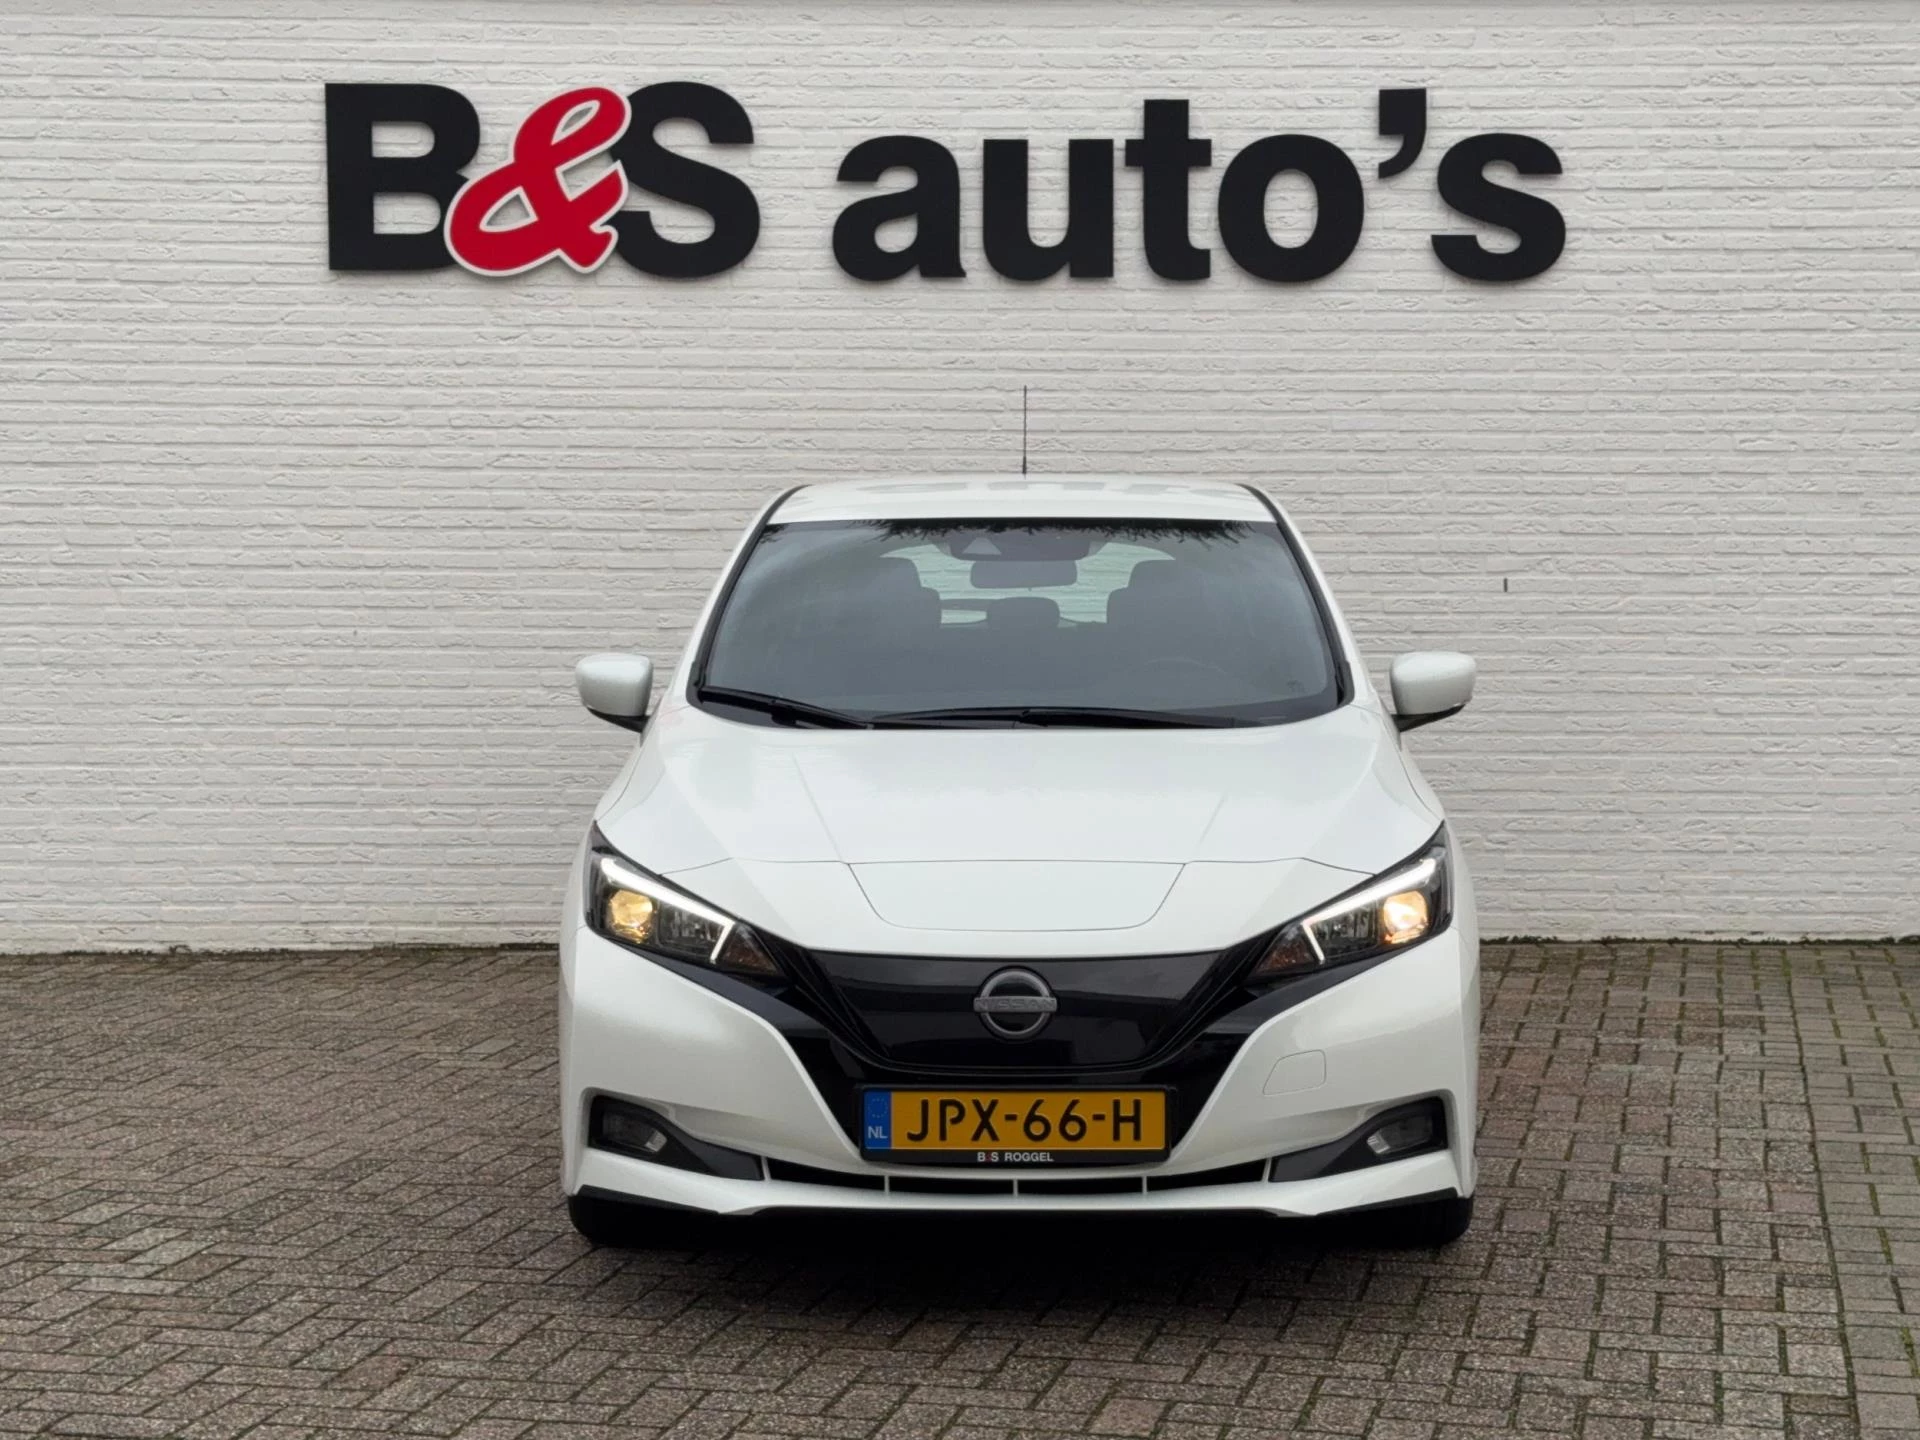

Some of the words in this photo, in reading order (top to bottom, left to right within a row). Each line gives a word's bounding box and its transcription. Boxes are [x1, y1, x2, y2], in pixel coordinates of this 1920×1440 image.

[325, 81, 760, 279] B&S
[832, 88, 1567, 283] auto's
[975, 998, 1056, 1010] NISSAN
[906, 1099, 1142, 1142] JPX-66-H
[868, 1126, 888, 1138] NL
[1004, 1152, 1054, 1162] ROGGEL
